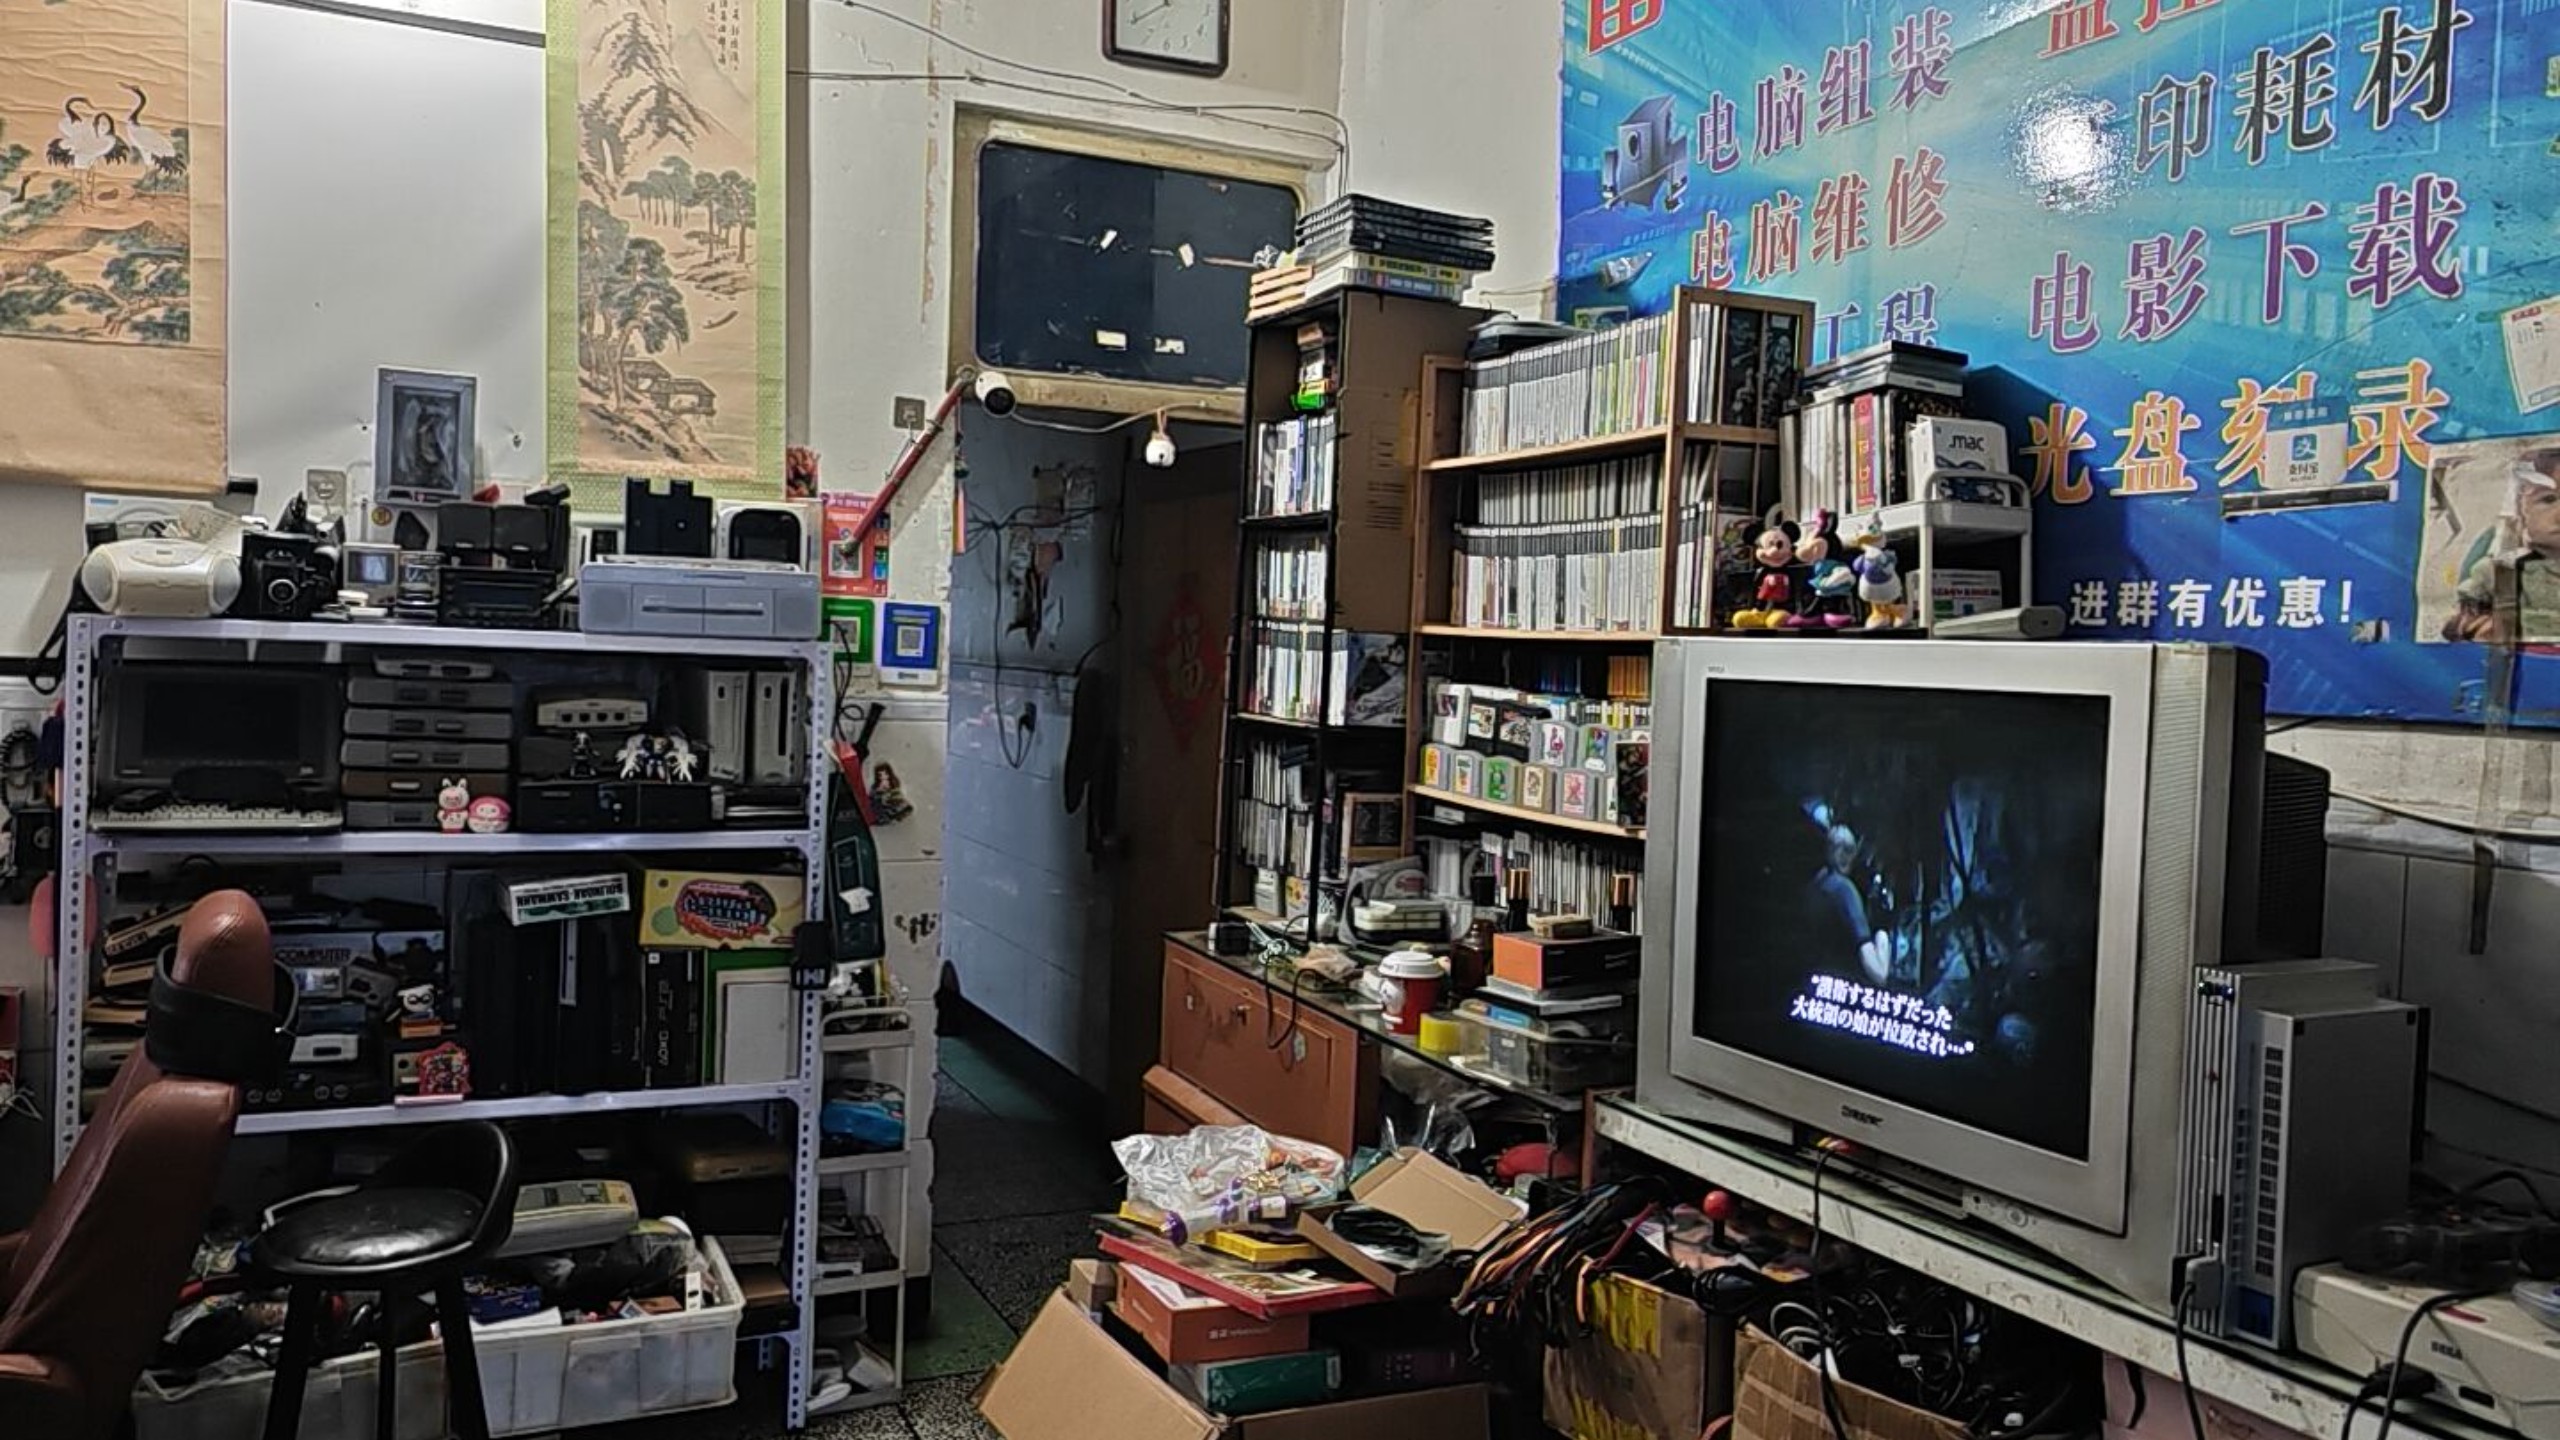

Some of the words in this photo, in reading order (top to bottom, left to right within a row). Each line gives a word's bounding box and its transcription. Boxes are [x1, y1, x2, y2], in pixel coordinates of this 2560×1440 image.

[1696, 7, 1953, 173] 电脑组装
[2060, 0, 2474, 205] 印耗材
[1690, 146, 1948, 289] 电脑维修
[2028, 173, 2465, 353] 电影下载
[2020, 358, 2450, 505] 光盘刻录
[2069, 576, 2353, 631] 进群有优惠！
